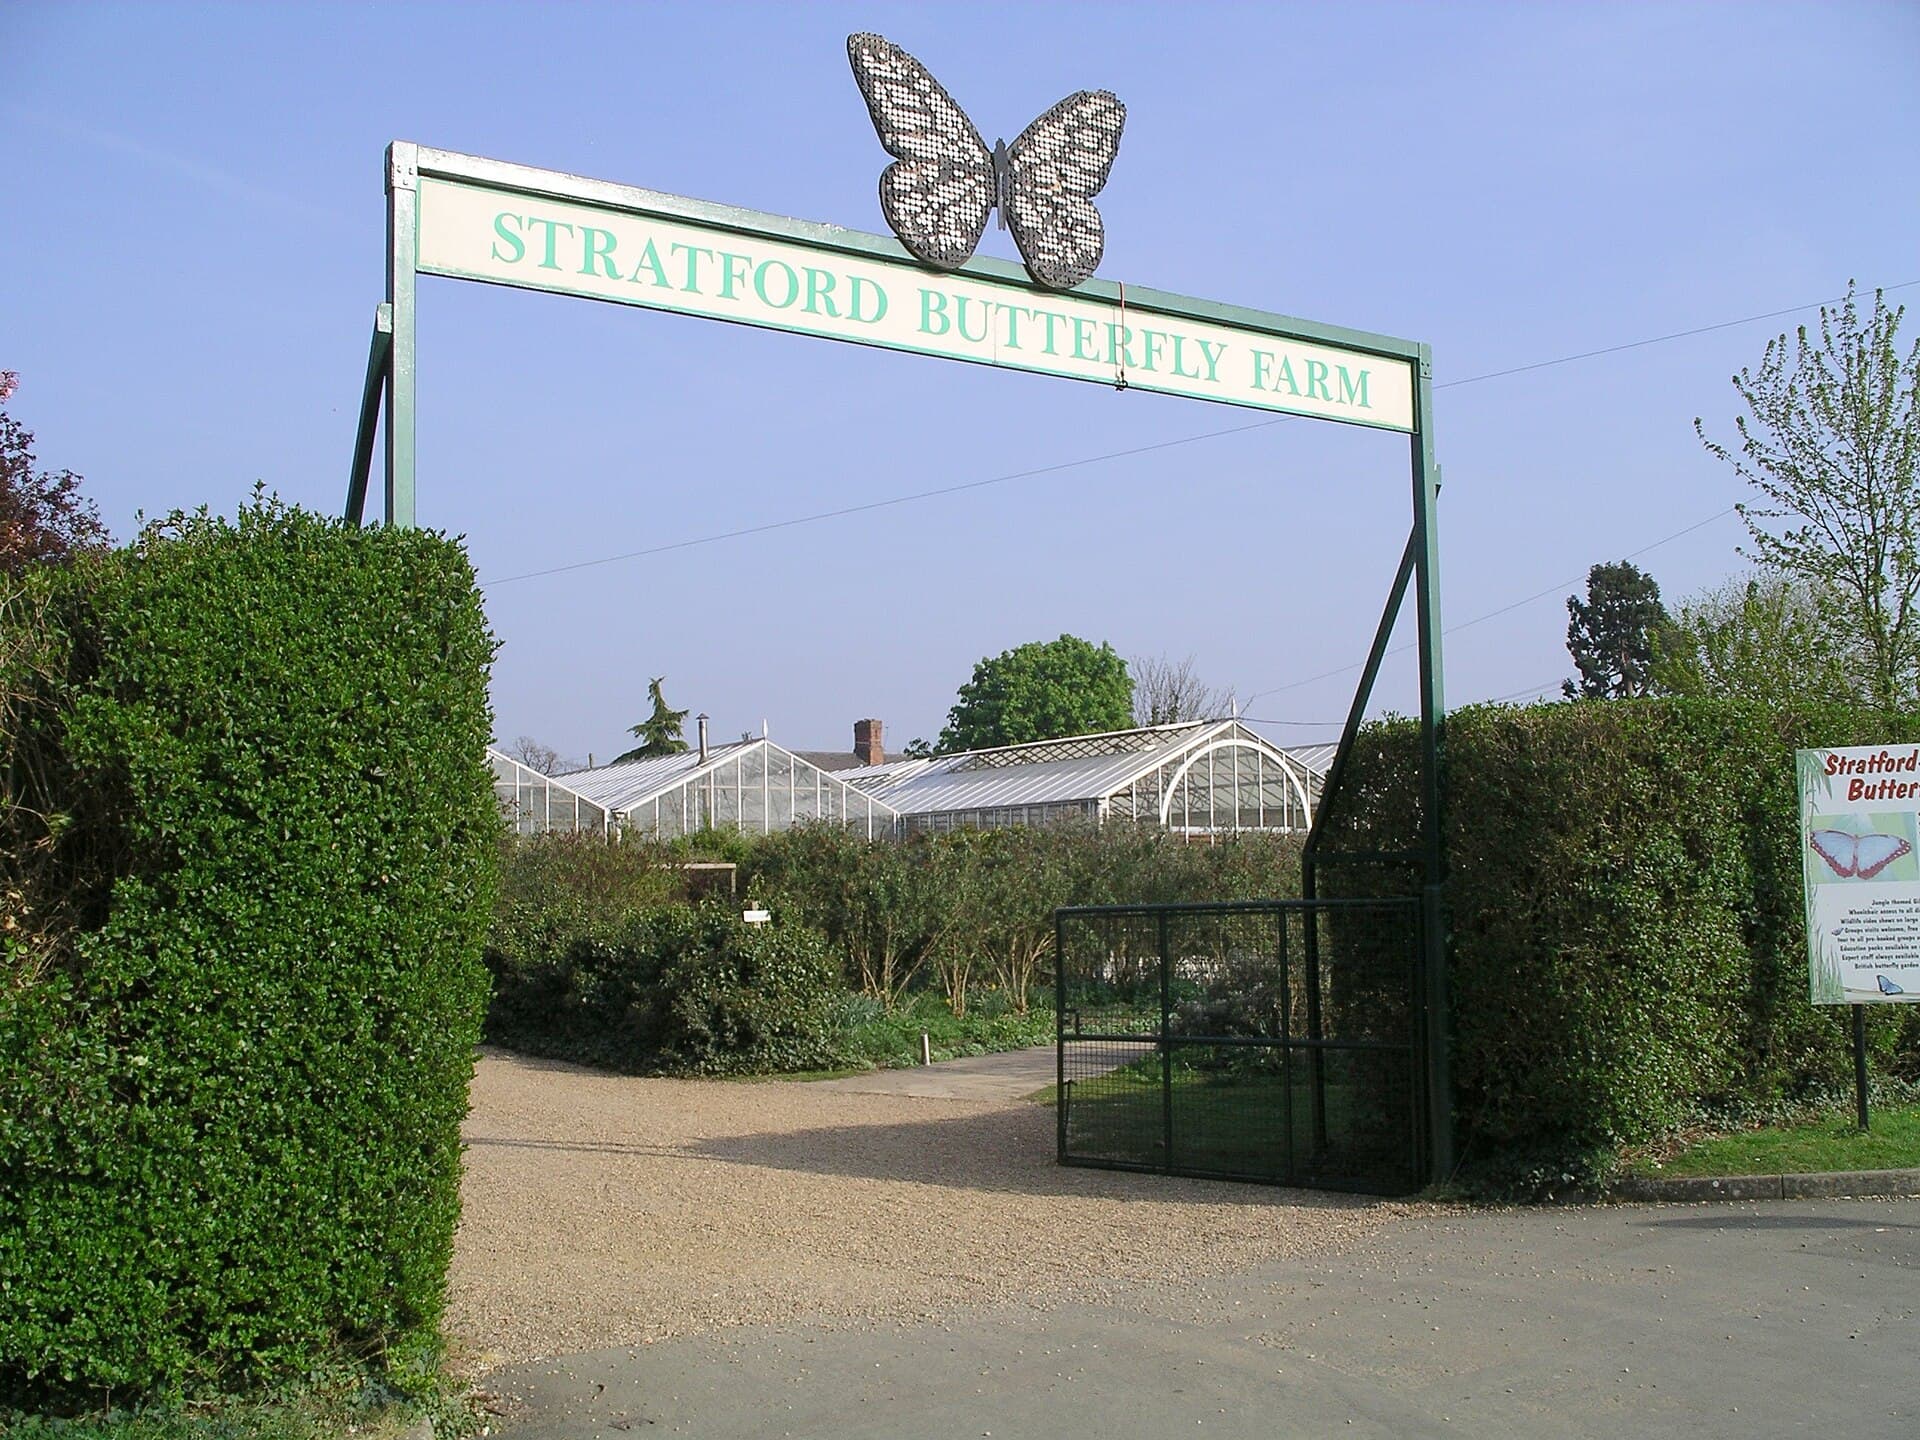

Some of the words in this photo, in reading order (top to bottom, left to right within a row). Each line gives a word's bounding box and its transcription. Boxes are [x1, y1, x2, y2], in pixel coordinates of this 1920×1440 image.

[491, 212, 888, 324] STRATFORD
[916, 288, 1229, 383] BUTTERFLY
[1249, 348, 1373, 409] FARM
[1824, 749, 1920, 776] Stratford
[1848, 778, 1920, 801] Butter
